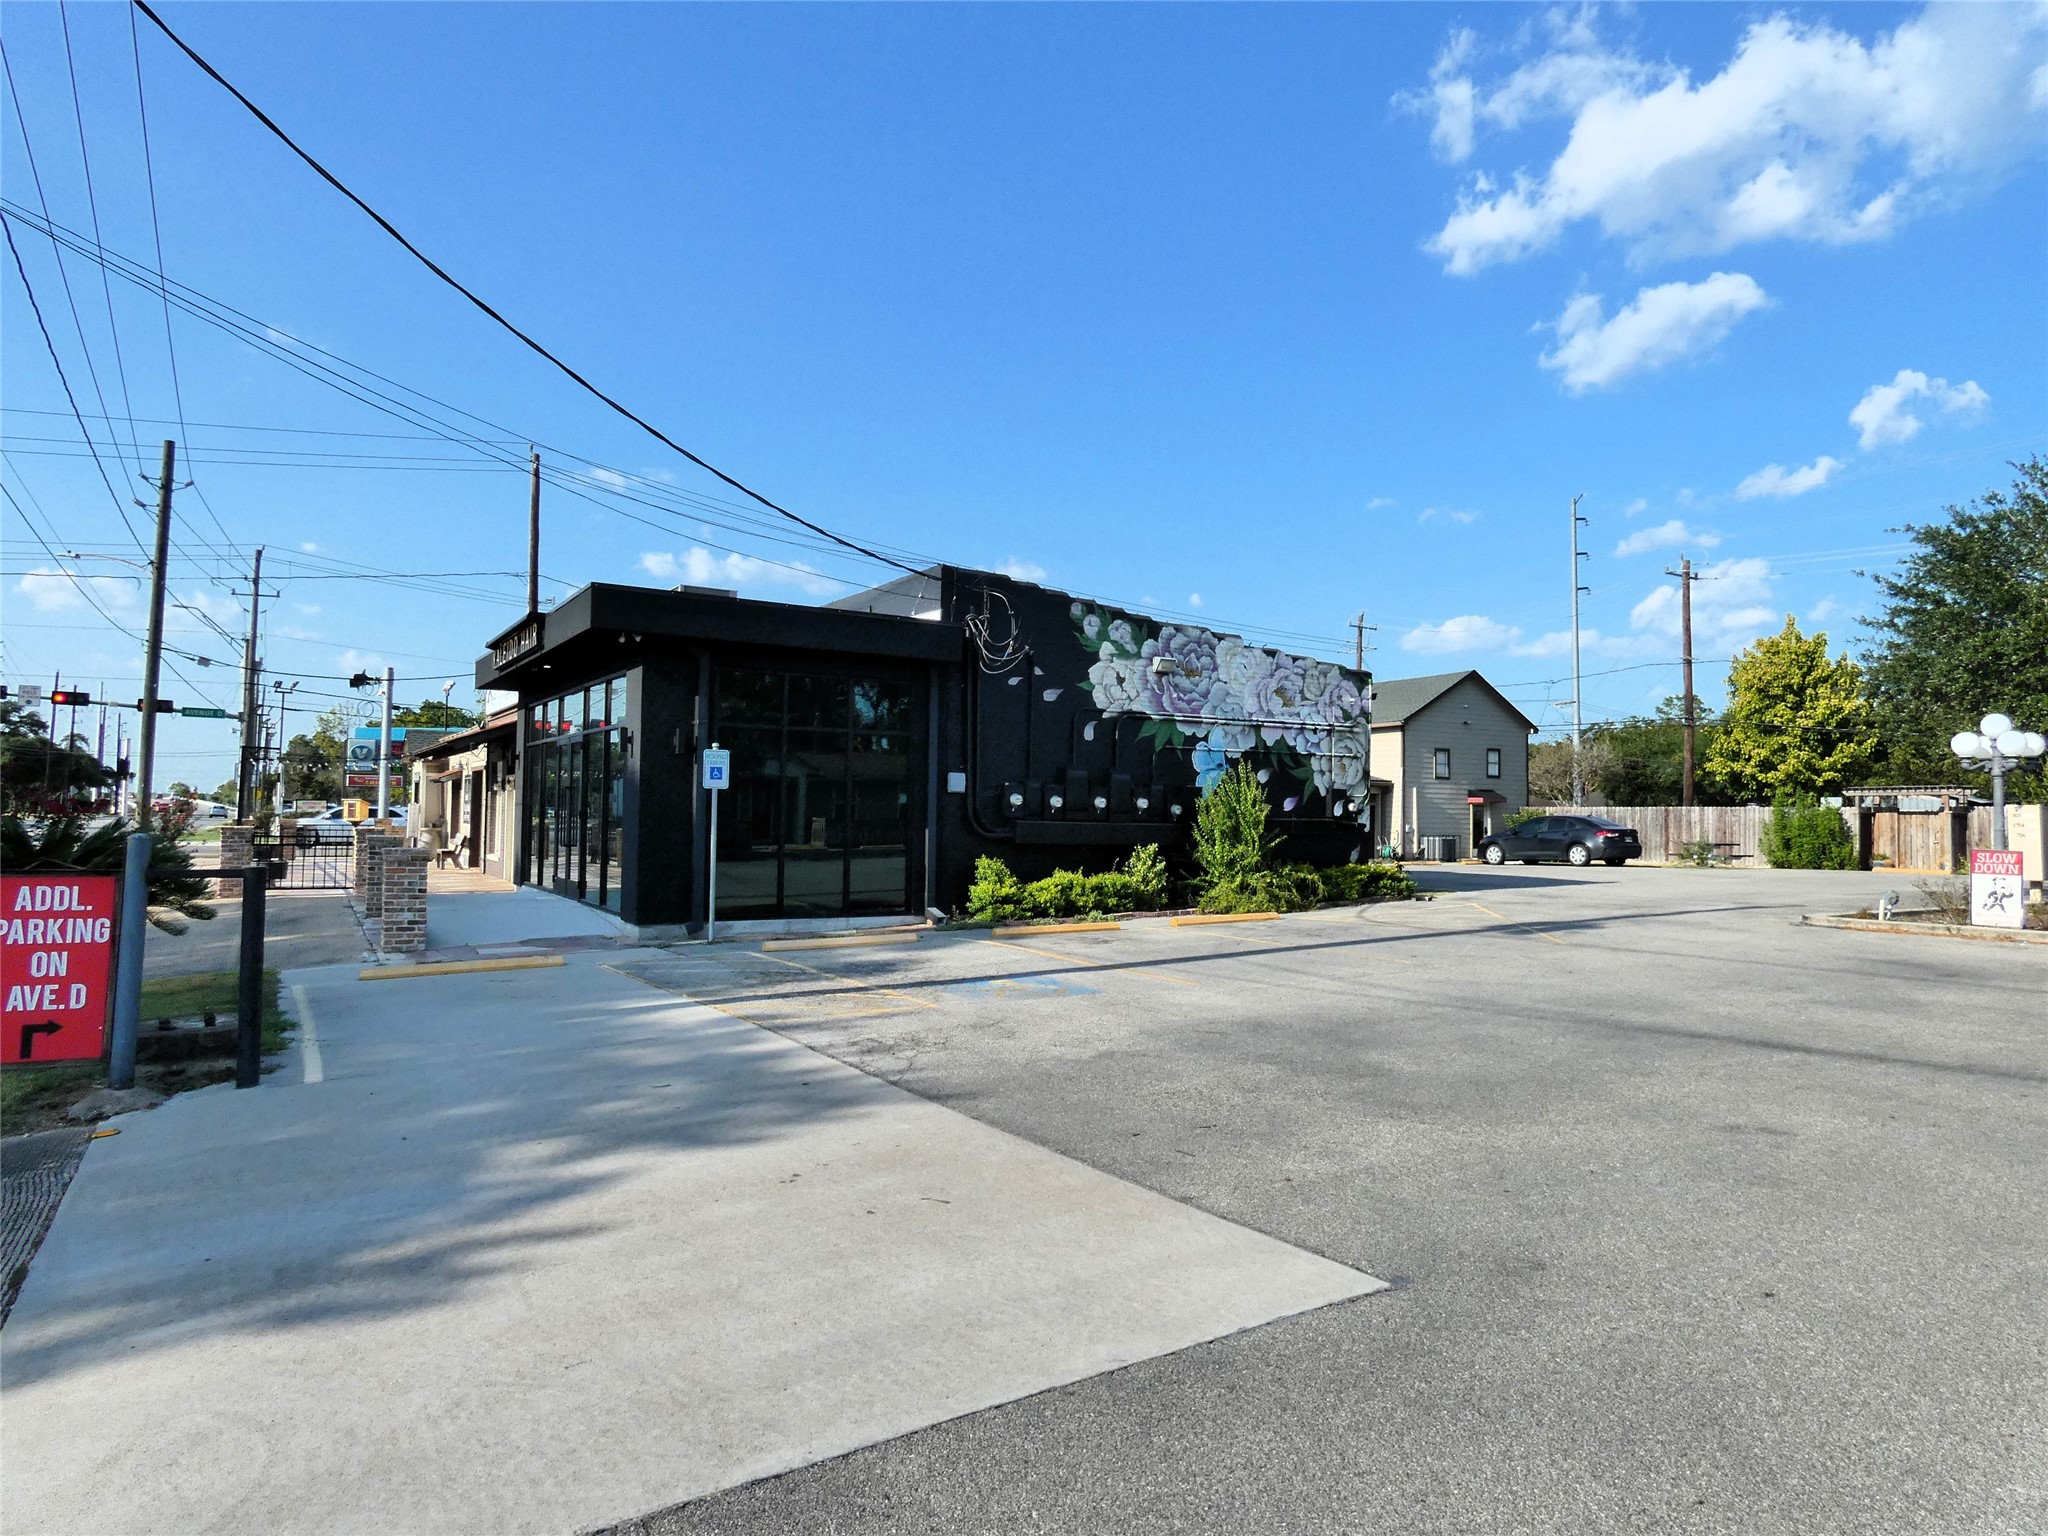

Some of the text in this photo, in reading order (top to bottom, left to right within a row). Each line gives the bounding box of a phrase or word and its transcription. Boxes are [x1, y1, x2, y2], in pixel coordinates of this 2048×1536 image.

[185, 709, 215, 717] AVENUE
[1976, 852, 2018, 864] SLOW
[1974, 862, 2019, 874] DOWN
[14, 885, 93, 911] ADDL.
[30, 951, 68, 978] ON
